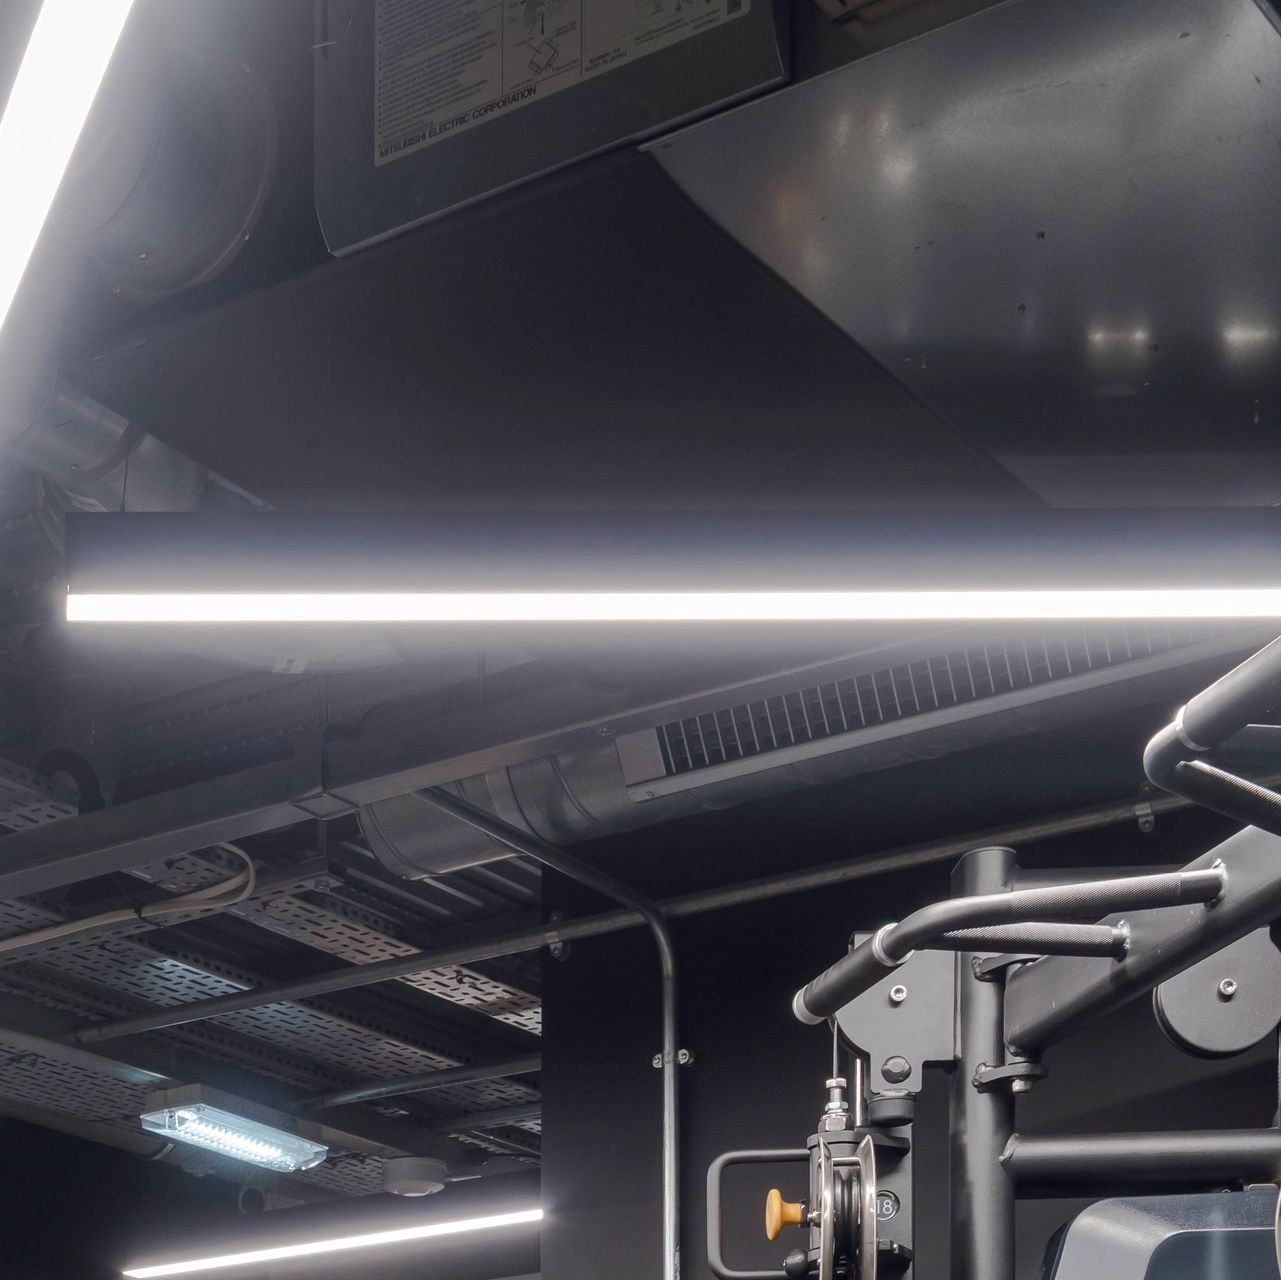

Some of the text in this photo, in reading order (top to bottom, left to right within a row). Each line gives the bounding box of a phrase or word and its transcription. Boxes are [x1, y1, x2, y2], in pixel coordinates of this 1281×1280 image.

[379, 85, 537, 159] MITSUBISHI ELECTRIC CORPORATION
